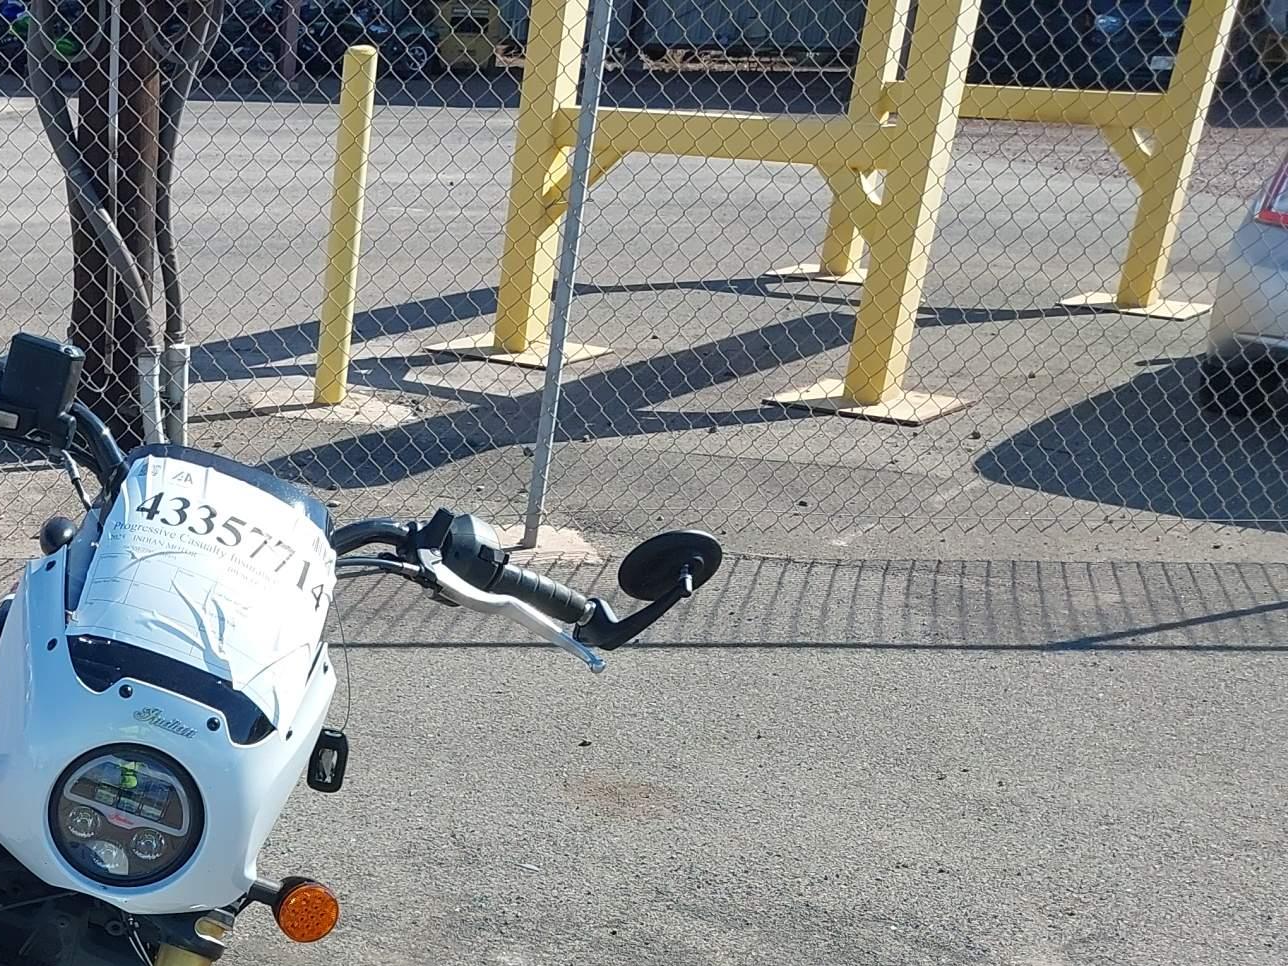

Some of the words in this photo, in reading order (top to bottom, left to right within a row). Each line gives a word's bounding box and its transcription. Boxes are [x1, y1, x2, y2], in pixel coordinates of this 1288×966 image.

[113, 521, 177, 539] Progressive
[179, 533, 227, 558] Casualty
[132, 534, 164, 547] INDIAN
[136, 491, 324, 612] 43357714
[133, 707, 197, 739] Indian
